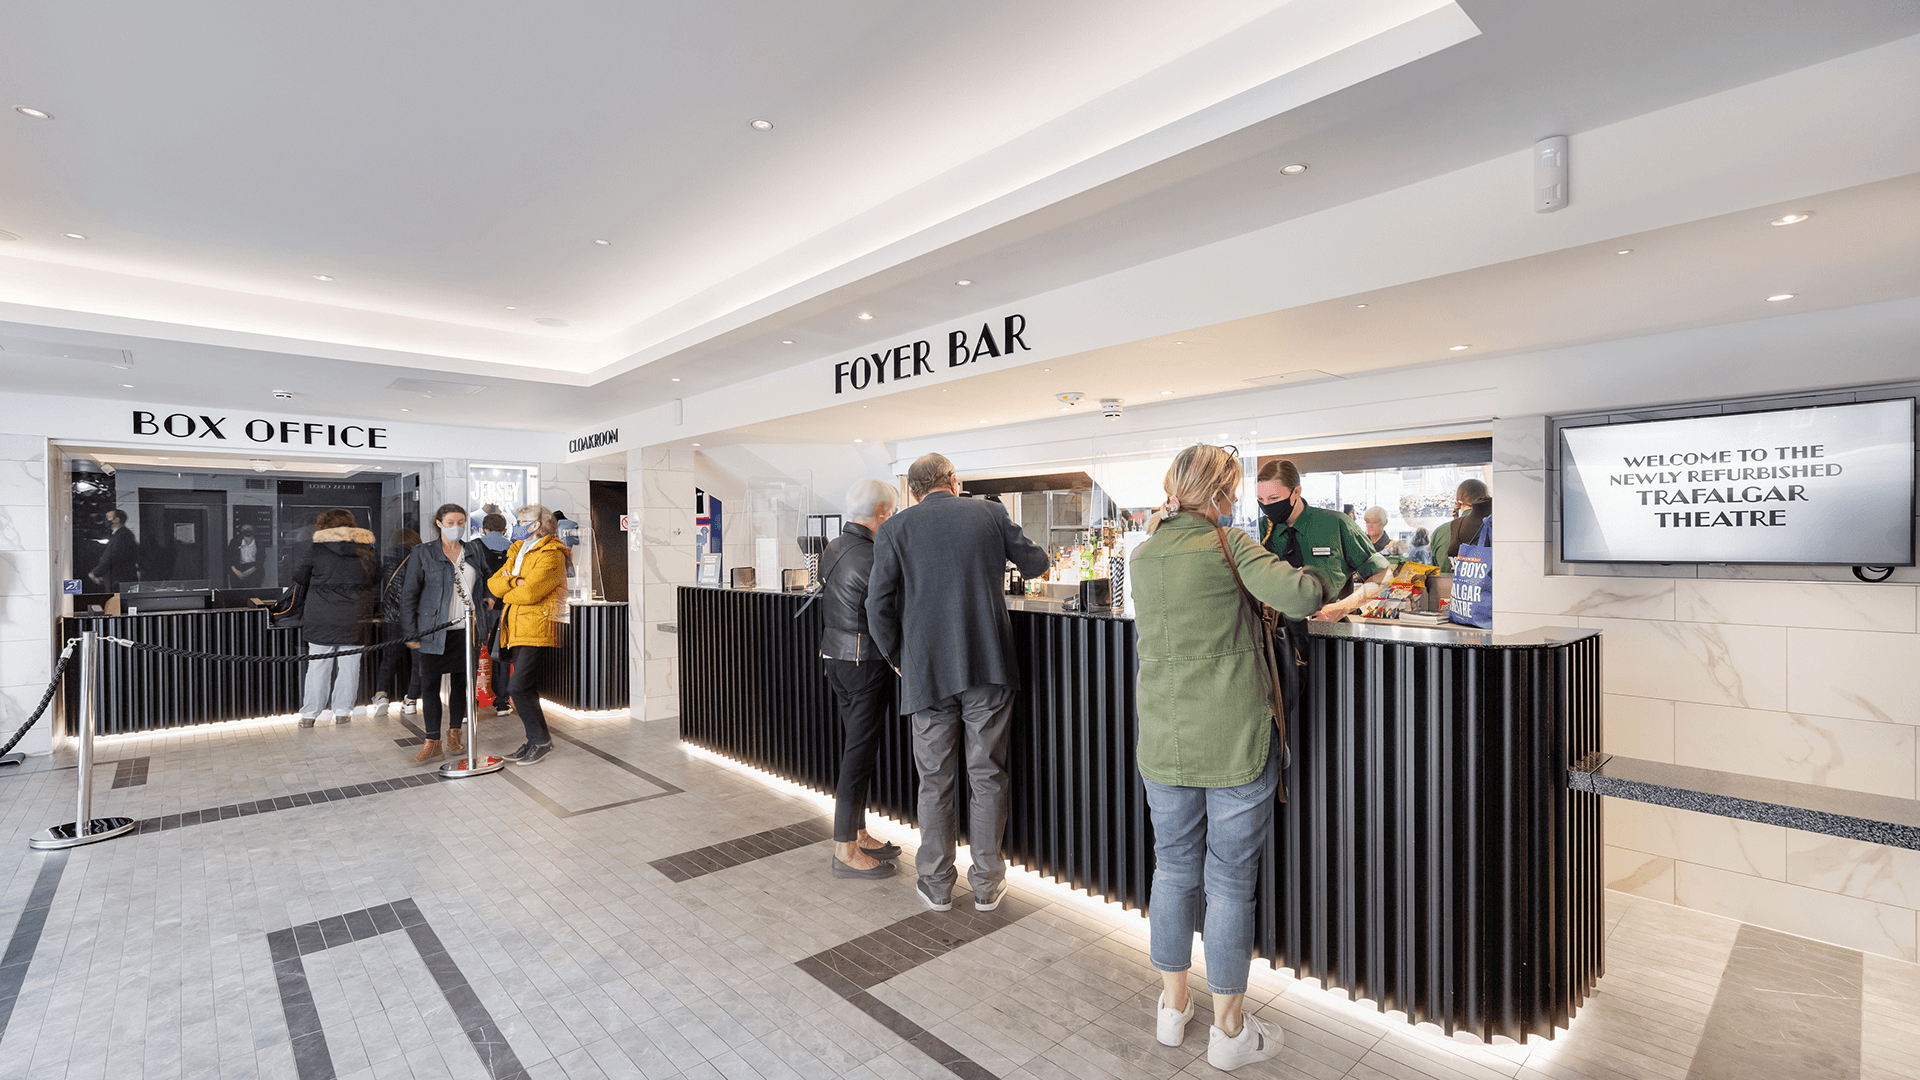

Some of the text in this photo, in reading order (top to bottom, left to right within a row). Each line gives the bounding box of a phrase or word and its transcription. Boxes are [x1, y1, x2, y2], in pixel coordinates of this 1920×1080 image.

[835, 313, 1031, 394] FOYER BAR
[133, 410, 387, 449] BOX OFFICE
[569, 427, 619, 453] CLOAKROOM
[1623, 444, 1824, 468] WELCOME TO THE
[1610, 463, 1843, 486] NEWLY REFURBISHED
[471, 480, 521, 502] JERSEY
[1636, 484, 1809, 505] TRAFALGAR
[1654, 509, 1786, 528] THEATRE
[1460, 561, 1487, 579] BOYS
